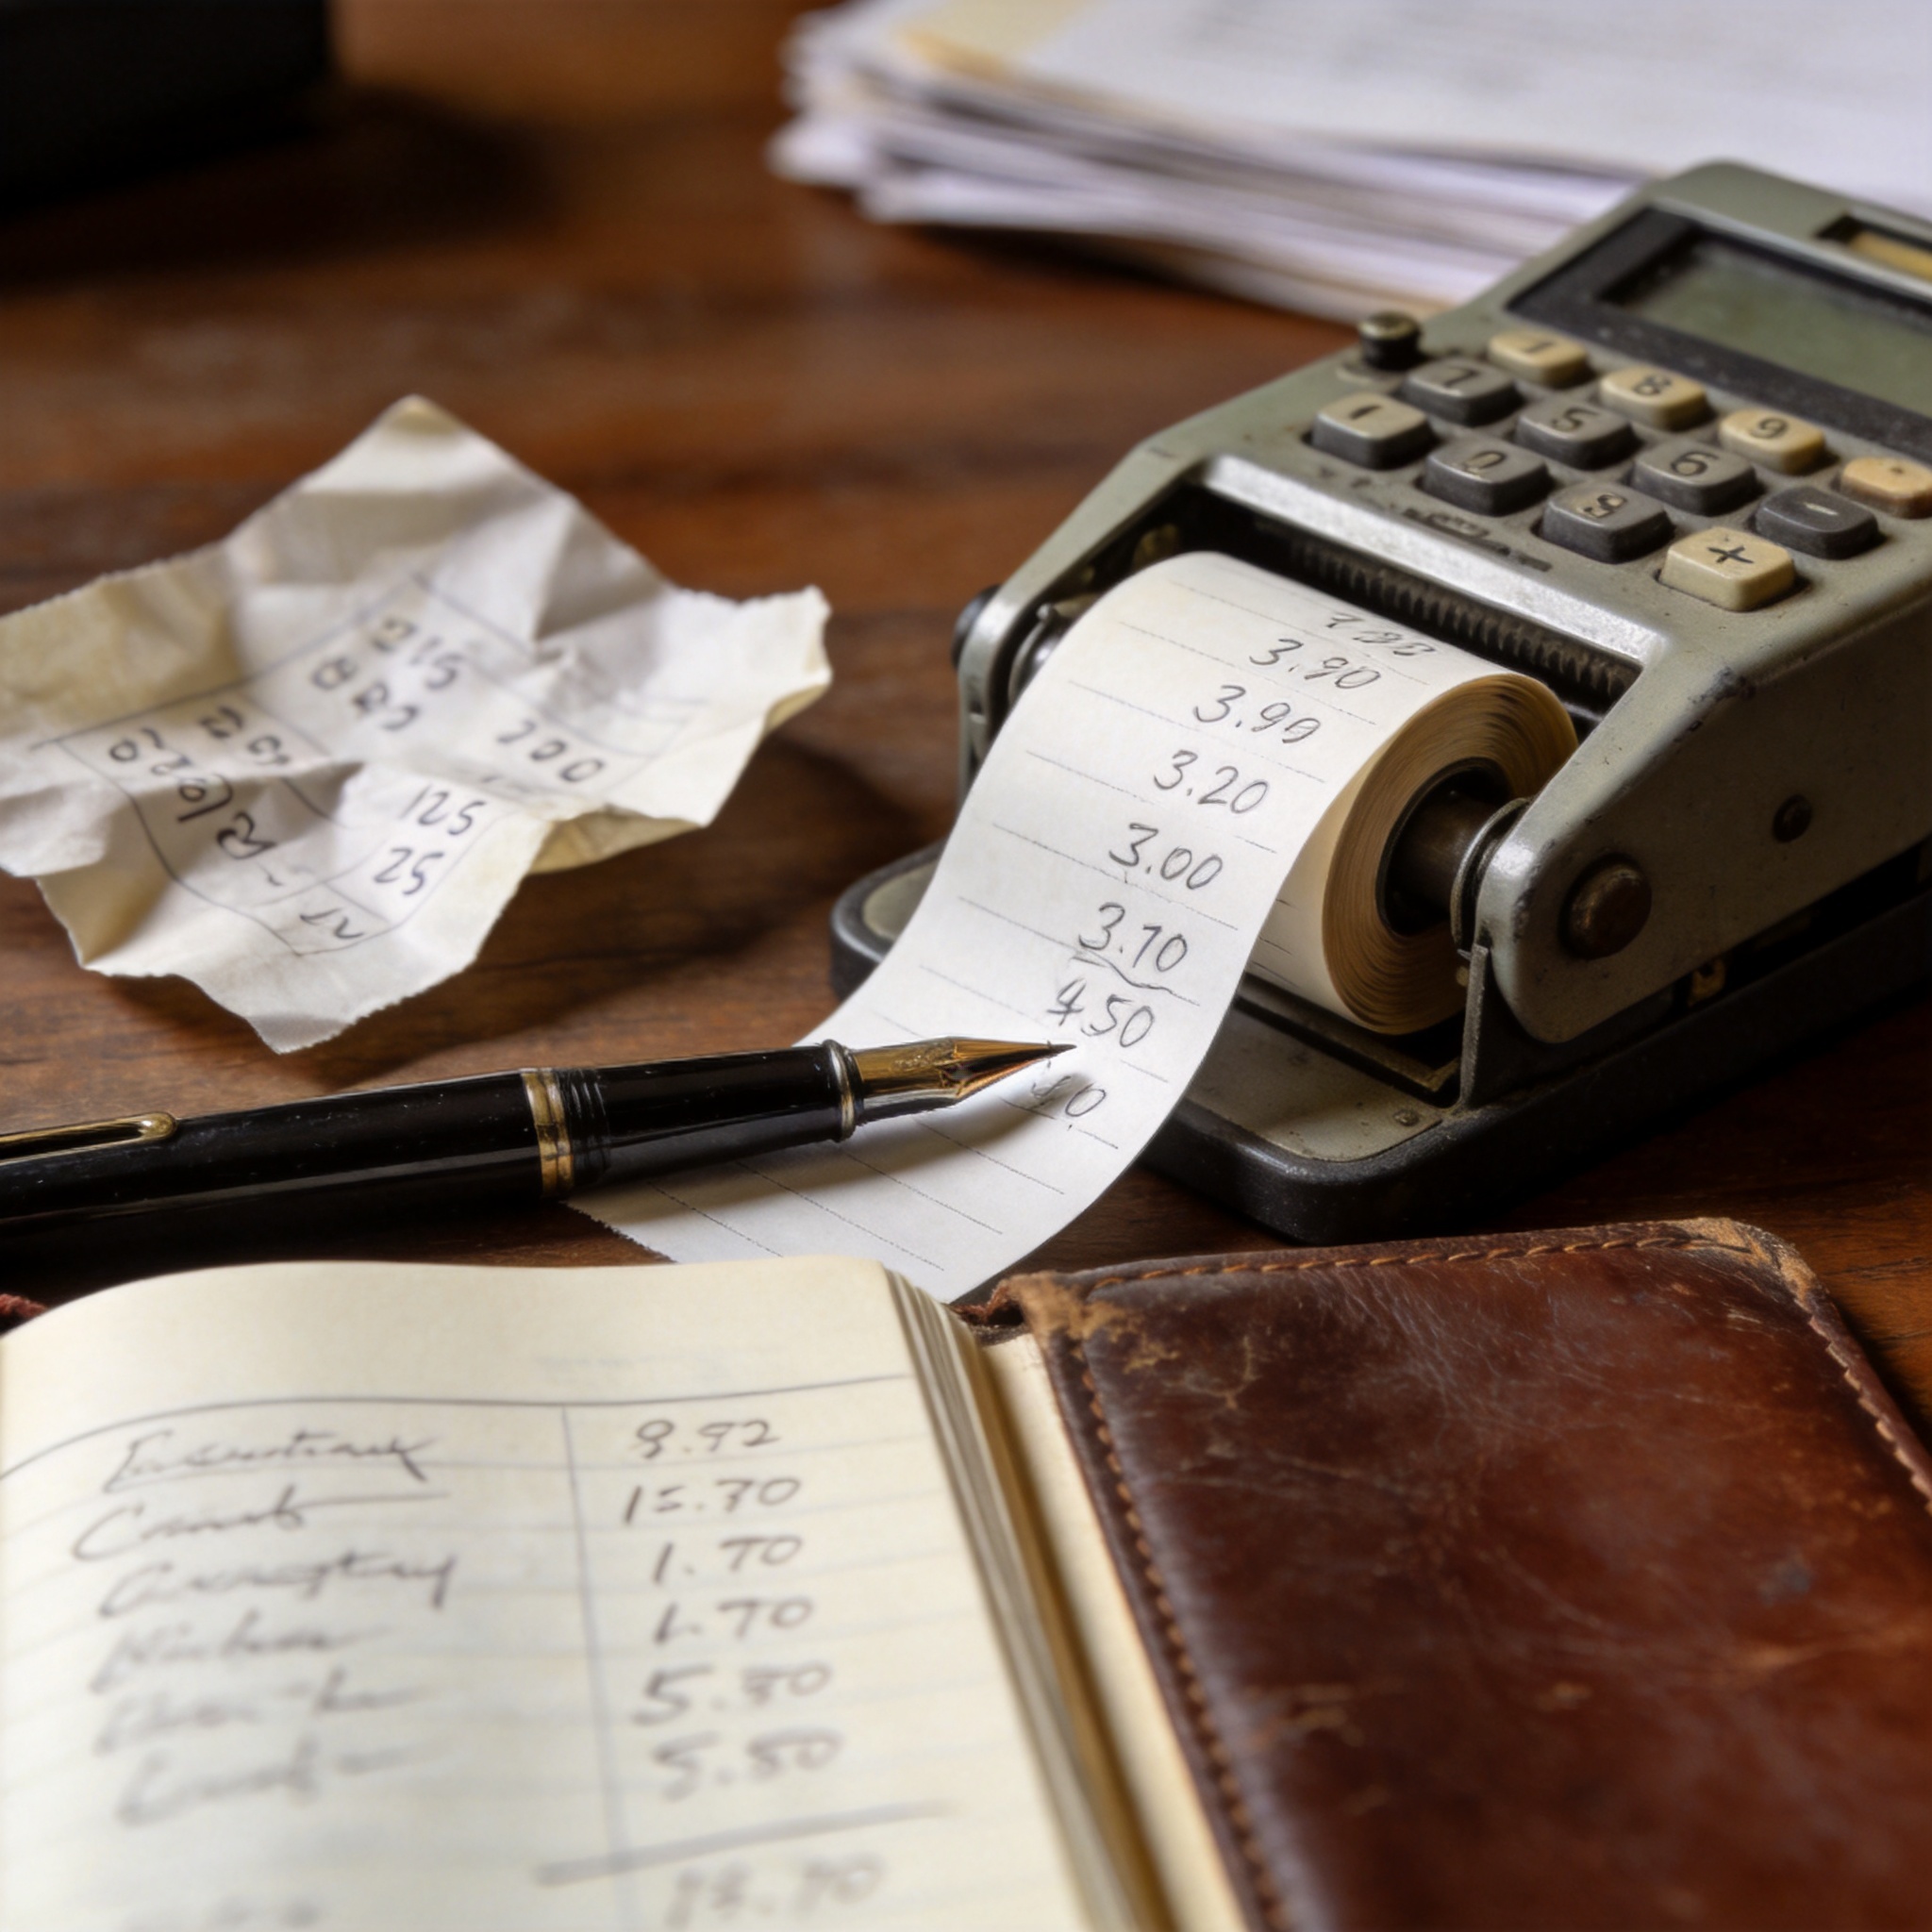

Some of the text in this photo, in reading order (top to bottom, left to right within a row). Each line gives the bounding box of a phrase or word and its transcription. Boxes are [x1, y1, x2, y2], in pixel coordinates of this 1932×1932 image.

[1670, 451, 1720, 477] 6
[1153, 749, 1270, 815] 3.20
[399, 784, 489, 837] 125
[374, 846, 444, 897] 25
[1108, 822, 1224, 891] 3.00
